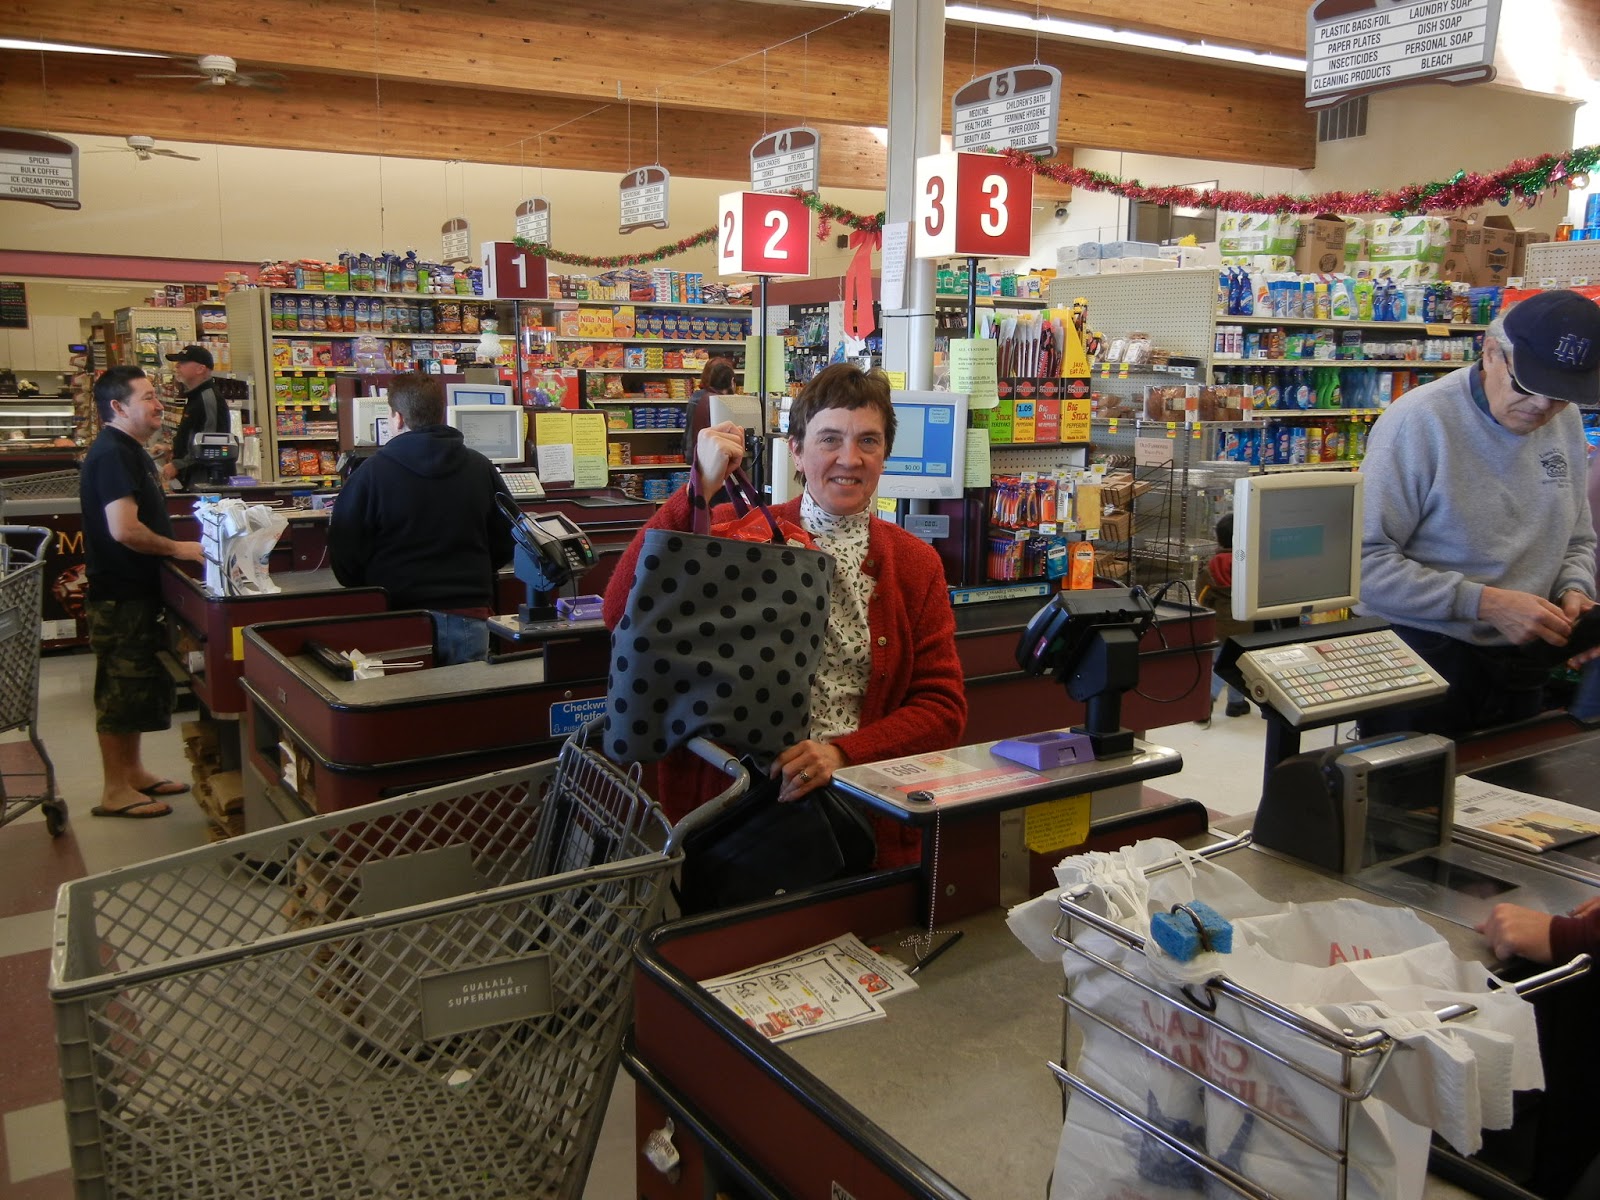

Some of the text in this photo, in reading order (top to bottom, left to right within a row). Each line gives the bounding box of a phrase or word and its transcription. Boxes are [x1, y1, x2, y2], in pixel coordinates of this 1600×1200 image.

[1409, 1, 1448, 20] LAUNDRY
[1321, 14, 1391, 39] PLASTIC BAGS/FOIL
[1418, 15, 1462, 35] DISH SOAP
[1328, 33, 1381, 54] PAPER PLATES
[1405, 31, 1473, 55] PERSONAL SOAP
[1328, 51, 1378, 70] INSECTICIDES
[1421, 54, 1453, 69] BLEACH
[996, 72, 1009, 97] 5
[1314, 65, 1391, 90] CLEANING PRODUCTS
[1006, 94, 1046, 110] CHILDREN'S BATH
[969, 107, 989, 118] MEDICINE
[1005, 107, 1046, 123] FEMININE HYGIENE
[965, 119, 992, 131] HEALTH CARE
[1009, 121, 1040, 135] PAPER GOODS
[778, 133, 787, 151] 4
[964, 132, 991, 144] BEAUTY AIDS
[1010, 135, 1038, 147] TRAVEL SIZE
[797, 152, 805, 160] FOOD
[794, 162, 808, 171] SUPPLIES
[639, 170, 645, 186] 3
[10, 186, 72, 197] CHARCOAL/FIREWOOD
[528, 200, 534, 213] 2
[925, 174, 1009, 238] 3 3
[723, 209, 789, 259] 2 2
[485, 254, 527, 288] 1 1
[575, 711, 605, 722] Platfo
[883, 763, 927, 777] 1993
[462, 976, 513, 993] GUALALA
[448, 984, 528, 1008] SUPERMARKET
